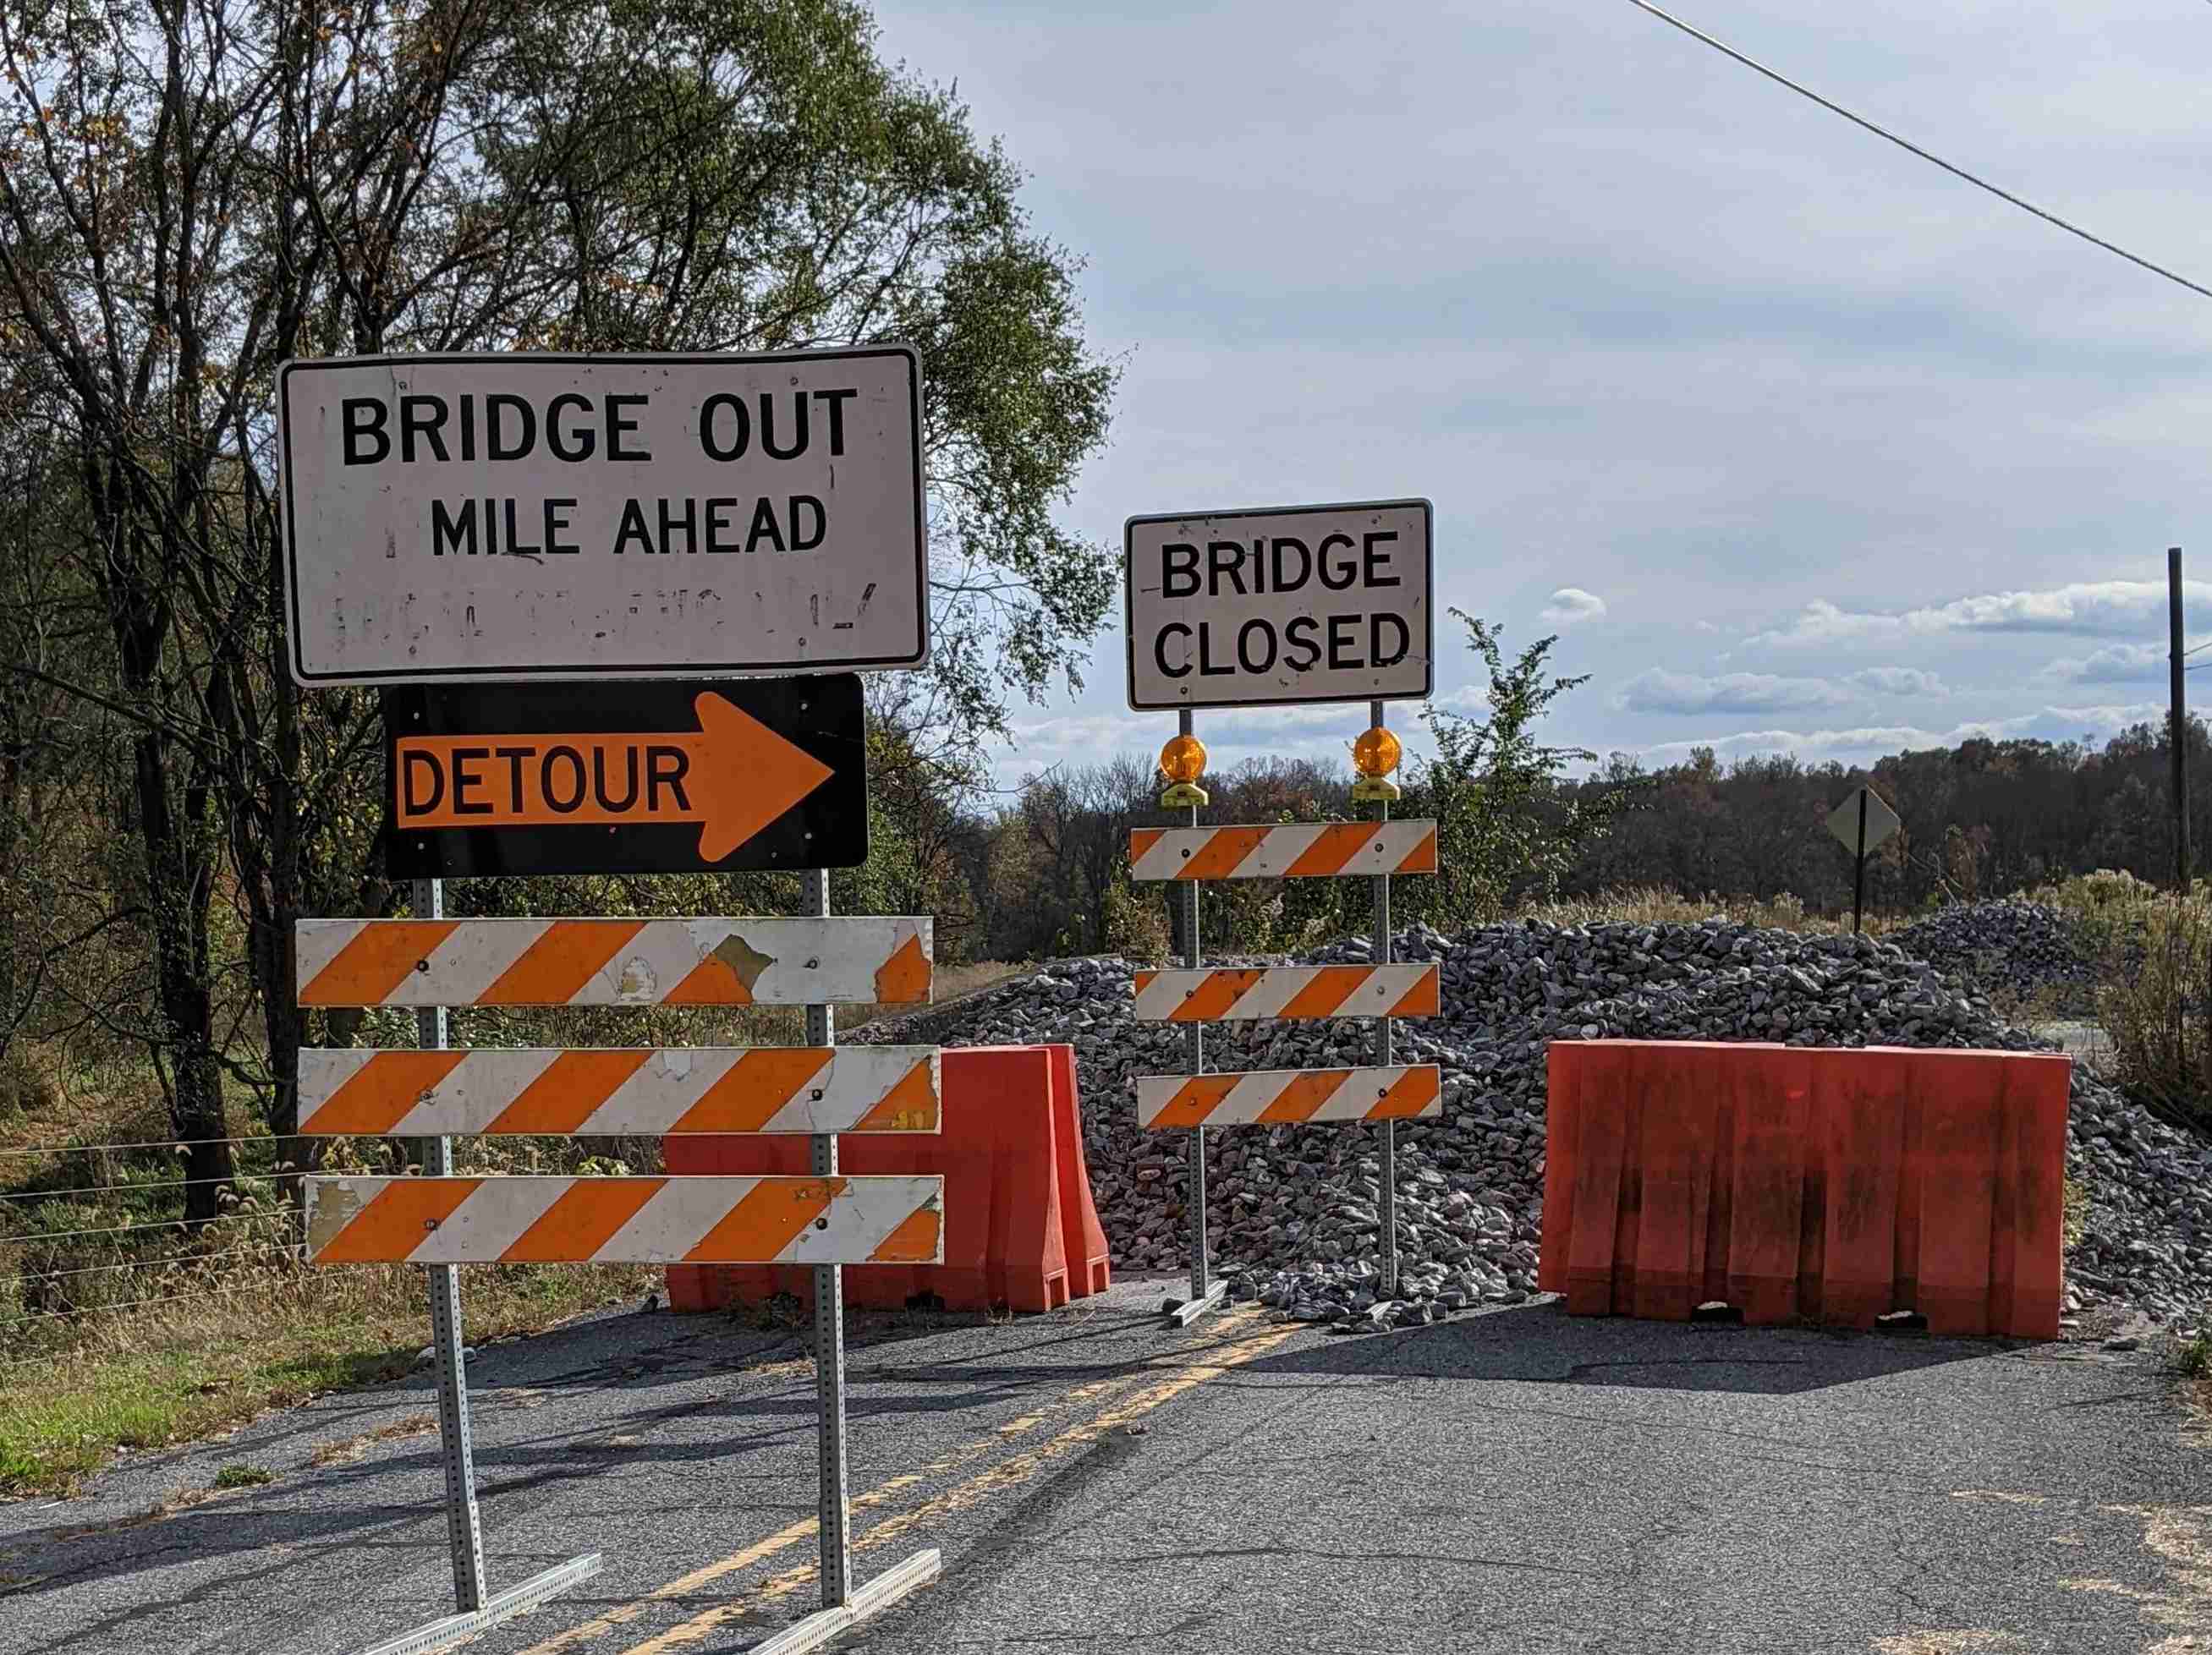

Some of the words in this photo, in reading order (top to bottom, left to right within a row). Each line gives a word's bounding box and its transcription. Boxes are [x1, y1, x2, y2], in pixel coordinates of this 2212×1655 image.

[342, 392, 651, 466] BRIDGE
[699, 388, 858, 462] OUT
[431, 498, 580, 556] MILE
[613, 495, 826, 554] AHEAD
[1161, 530, 1401, 599] BRIDGE
[1154, 612, 1410, 678] CLOSED
[403, 745, 692, 816] DETOUR
